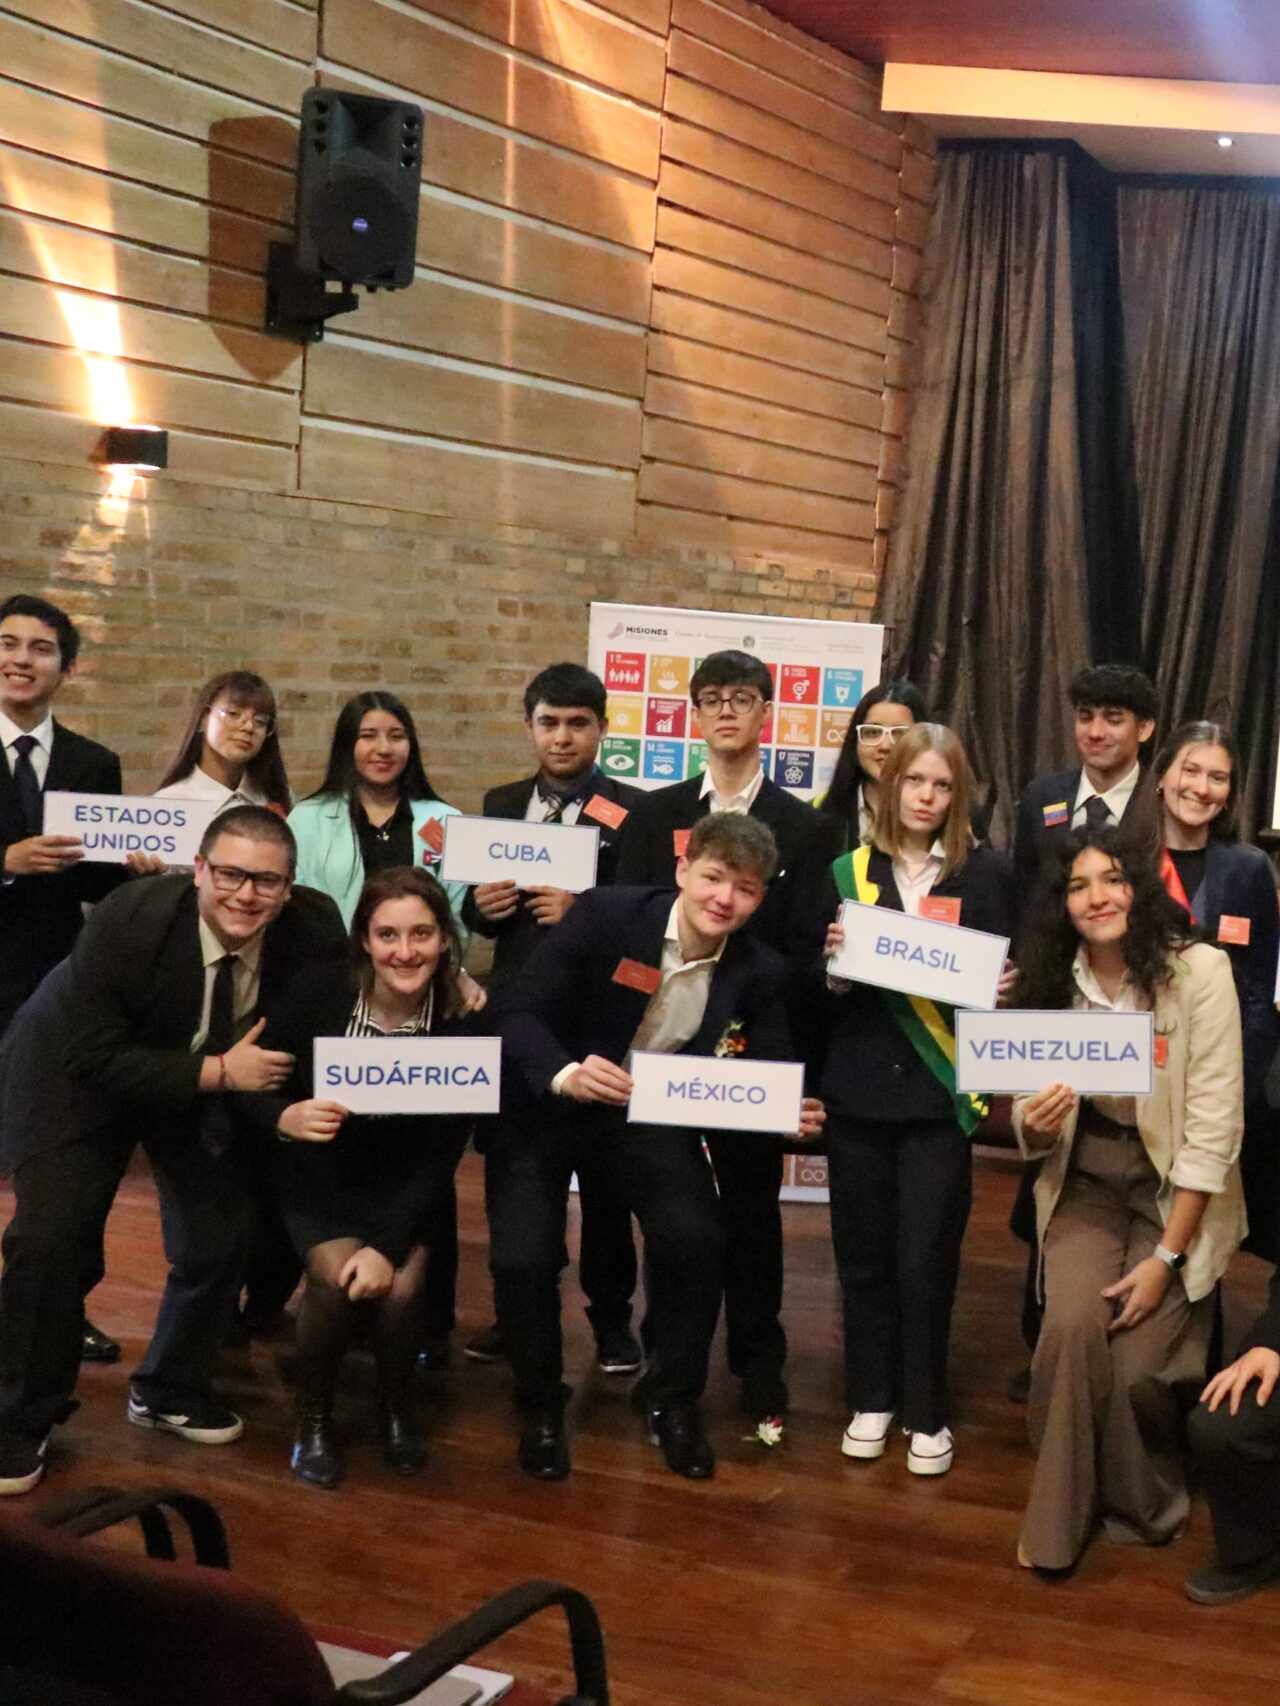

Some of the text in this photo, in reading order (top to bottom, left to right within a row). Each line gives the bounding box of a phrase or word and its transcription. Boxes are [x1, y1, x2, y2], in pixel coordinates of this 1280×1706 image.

[626, 626, 669, 636] MISIONES
[74, 804, 187, 827] ESTADOS
[83, 832, 176, 853] UNIDOS
[488, 842, 552, 864] CUBA
[875, 935, 962, 974] BRASIL
[969, 1039, 1140, 1062] VENEZUELA
[326, 1060, 491, 1086] SUDÁFRICA
[666, 1076, 767, 1105] MÉXICO
